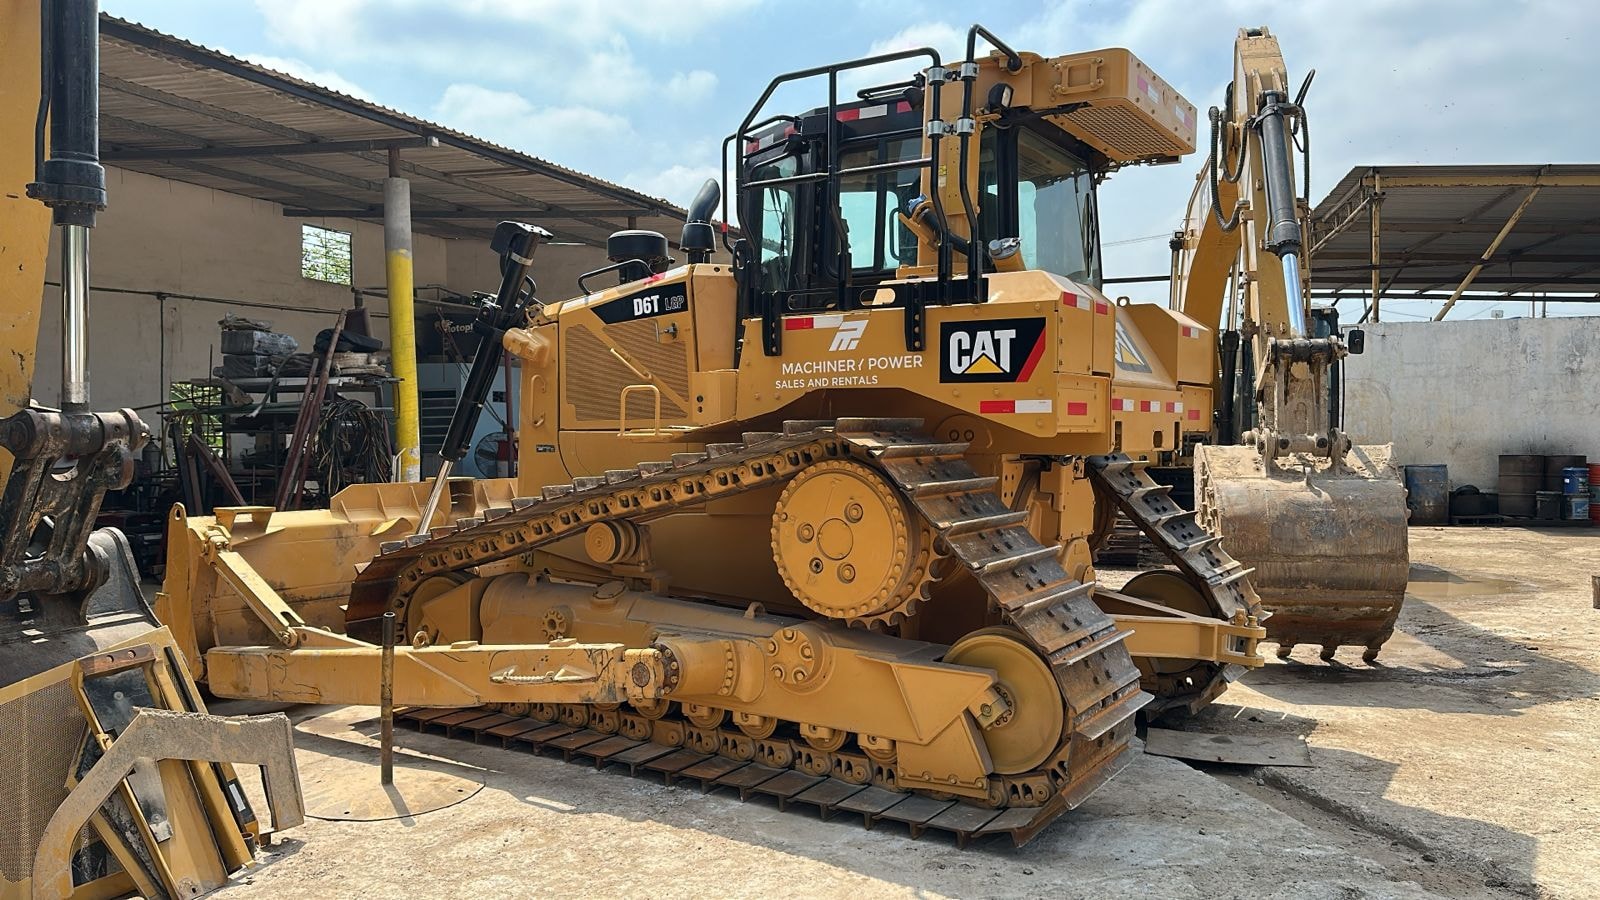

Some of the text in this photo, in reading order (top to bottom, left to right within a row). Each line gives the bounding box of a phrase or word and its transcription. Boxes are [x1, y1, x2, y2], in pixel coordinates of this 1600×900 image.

[633, 294, 685, 316] D6T LGP
[949, 328, 1016, 375] CAT
[868, 354, 923, 370] POWER
[775, 375, 878, 390] SALES AND RENTALS
